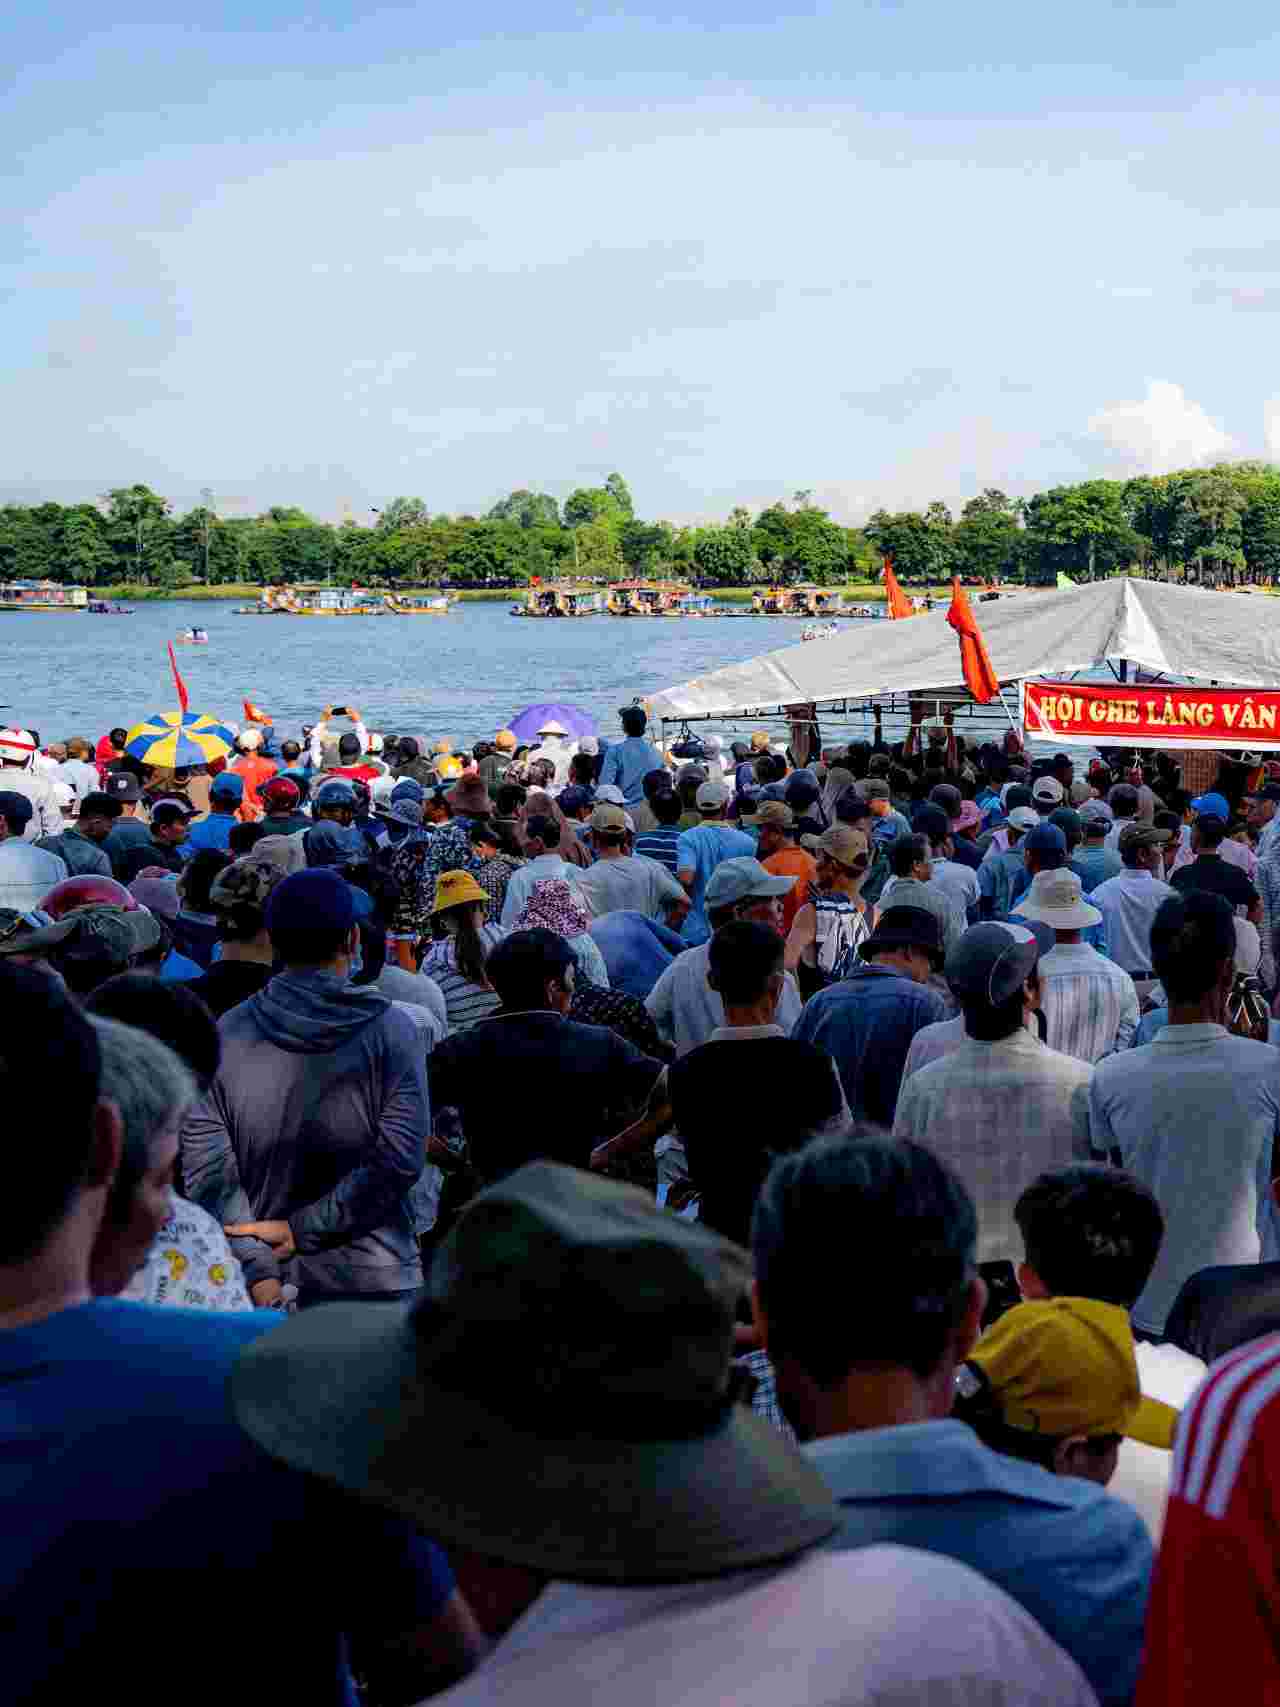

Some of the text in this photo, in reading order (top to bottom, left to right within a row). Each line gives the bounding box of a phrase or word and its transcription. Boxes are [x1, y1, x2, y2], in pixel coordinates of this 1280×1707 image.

[1040, 694, 1083, 728] HỘI
[1089, 700, 1140, 724] GHE
[1222, 698, 1277, 729] VÂN
